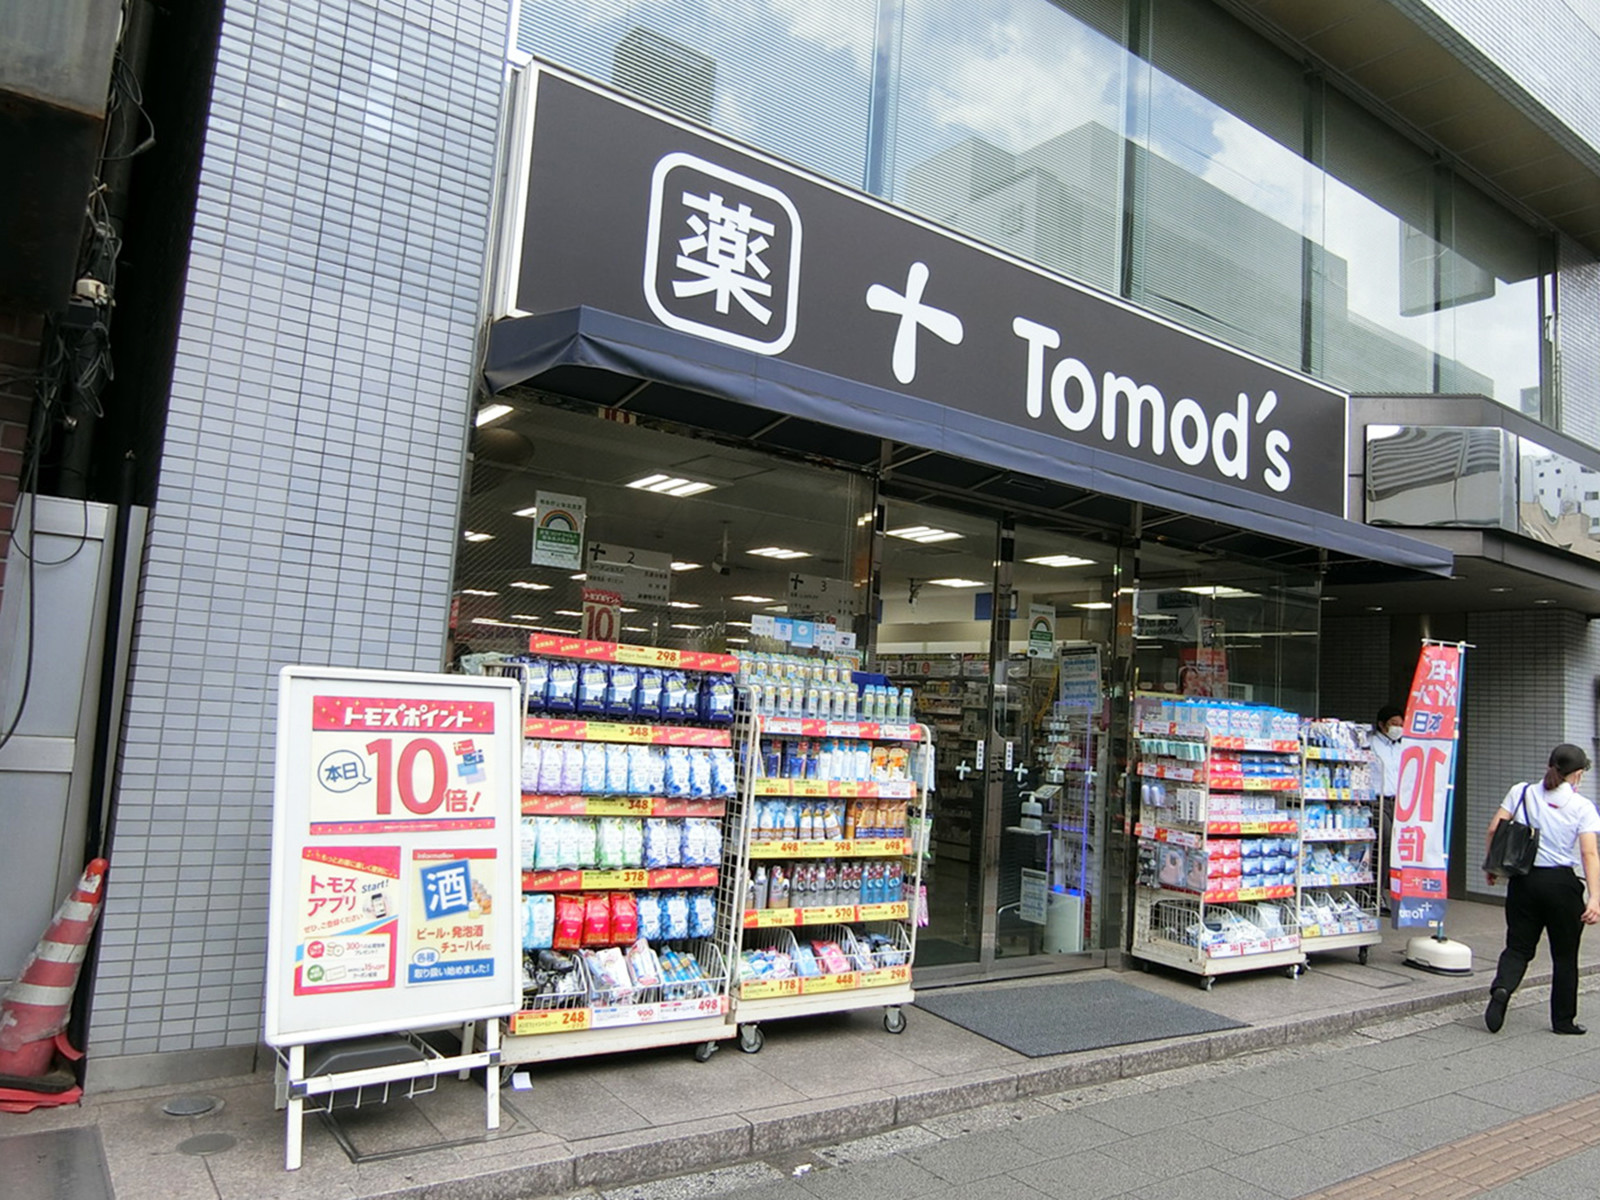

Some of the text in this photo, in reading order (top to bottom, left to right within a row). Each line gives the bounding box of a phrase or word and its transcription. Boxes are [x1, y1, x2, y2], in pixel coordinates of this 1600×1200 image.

[672, 190, 775, 326] 薬
[1013, 316, 1292, 493] Tomod's
[627, 552, 635, 564] 2
[820, 581, 827, 592] 3
[585, 605, 614, 641] 10
[656, 651, 677, 661] 298
[344, 704, 474, 728] トモズポイント
[628, 726, 649, 736] 348
[325, 762, 358, 782] 本日
[628, 799, 649, 809] 348
[781, 843, 799, 852] 498
[835, 842, 852, 852] 598
[885, 841, 900, 850] 698
[624, 871, 644, 881] 378
[310, 875, 357, 894] トモズ
[361, 879, 389, 893] Start!
[427, 867, 468, 911] 酒
[307, 895, 356, 917] アプリ
[890, 904, 906, 914] 570
[835, 908, 852, 918] 570
[417, 924, 484, 940] ビール・発泡酒
[417, 952, 436, 963] 各種
[836, 975, 854, 985] 448
[890, 970, 906, 979] 298
[779, 980, 796, 990] 178
[698, 1000, 718, 1011] 498
[562, 1011, 585, 1024] 248
